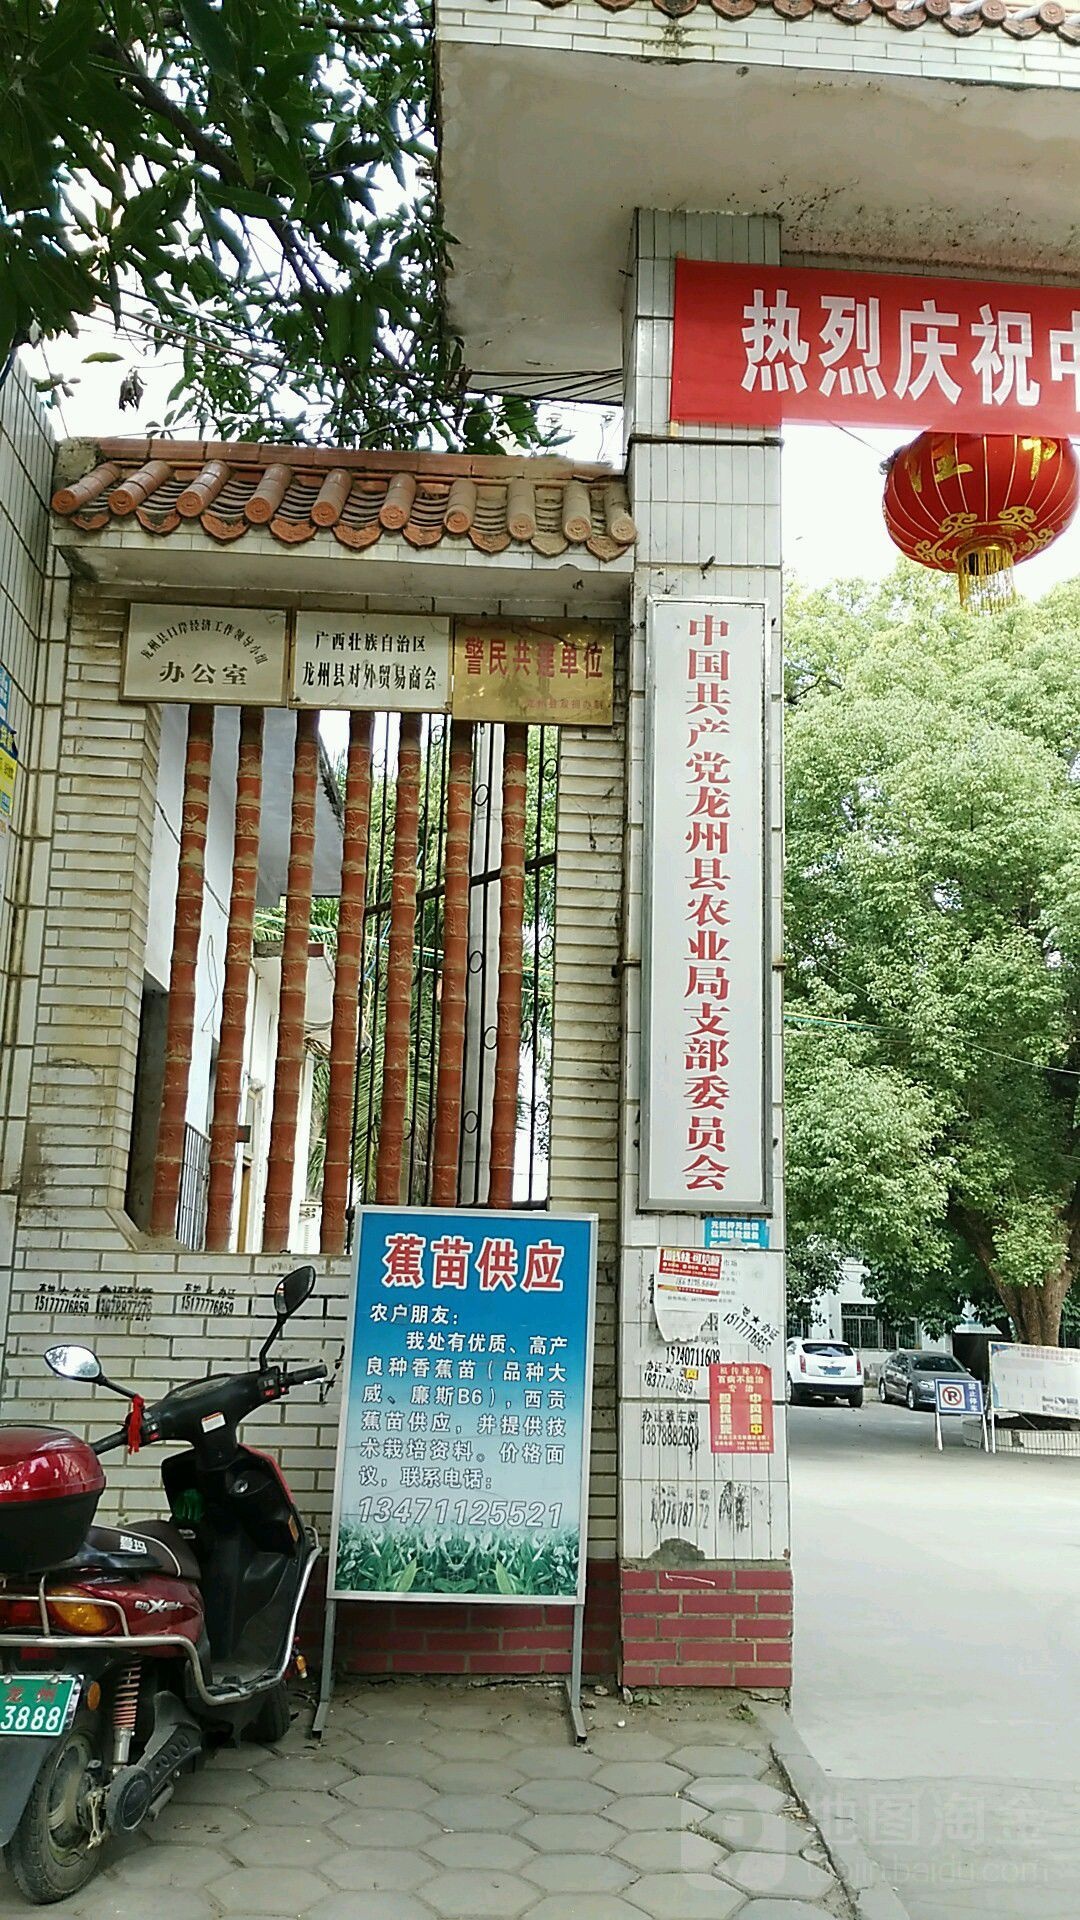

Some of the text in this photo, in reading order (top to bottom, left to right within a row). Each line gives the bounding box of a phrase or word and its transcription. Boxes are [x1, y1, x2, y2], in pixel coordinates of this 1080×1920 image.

[140, 618, 269, 665] 龙州县口岸经济工作领导小组
[315, 630, 426, 653] 广西壮族自治区
[465, 636, 603, 679] 警民共建单位
[159, 661, 248, 685] 办公室
[302, 661, 437, 690] 龙州县对外贸易商会
[682, 614, 731, 1191] 中国共产党龙州县农业局支部委员会
[382, 1234, 565, 1292] 蕉苗供应
[369, 1303, 459, 1325] 农户朋友：
[406, 1331, 568, 1356] 我处有优质、高产
[361, 1410, 566, 1437] 蕉苗供应，并提供技
[360, 1438, 565, 1465] 术栽培资料。价格面
[359, 1466, 492, 1490] 议，联系电话：
[358, 1496, 563, 1529] 13471125521
[0, 1706, 61, 1731] 3888
